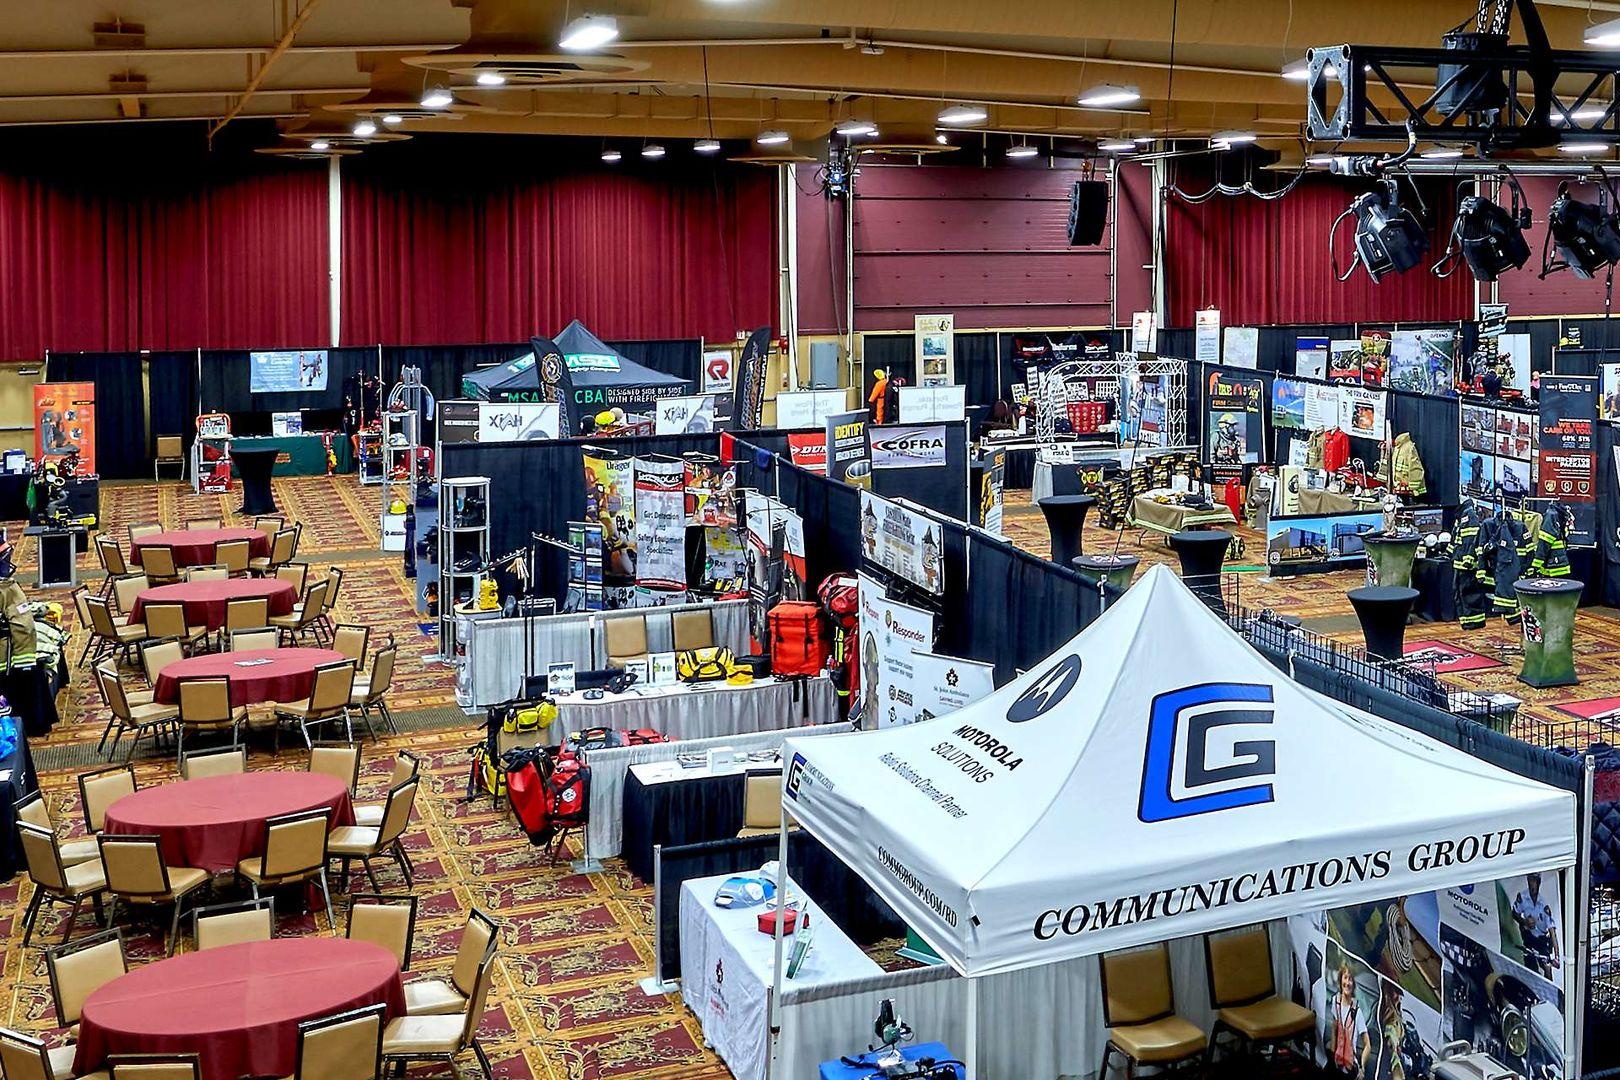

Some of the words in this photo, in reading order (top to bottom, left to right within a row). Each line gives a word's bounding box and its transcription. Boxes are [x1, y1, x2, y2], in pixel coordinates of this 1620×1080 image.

[608, 387, 639, 396] DESIGNED
[641, 387, 655, 395] SIDE
[668, 386, 683, 394] SIDE
[608, 395, 628, 404] WITH
[835, 422, 865, 440] IDENTIFY
[881, 438, 944, 450] COFRA
[892, 620, 926, 644] Responder
[951, 724, 1024, 772] MOTOROLA
[930, 741, 995, 783] SOLUTIONS
[1032, 851, 1392, 942] COMMUNICATIONS
[1407, 827, 1526, 873] GROUP
[1447, 889, 1490, 917] MOTOROLA
